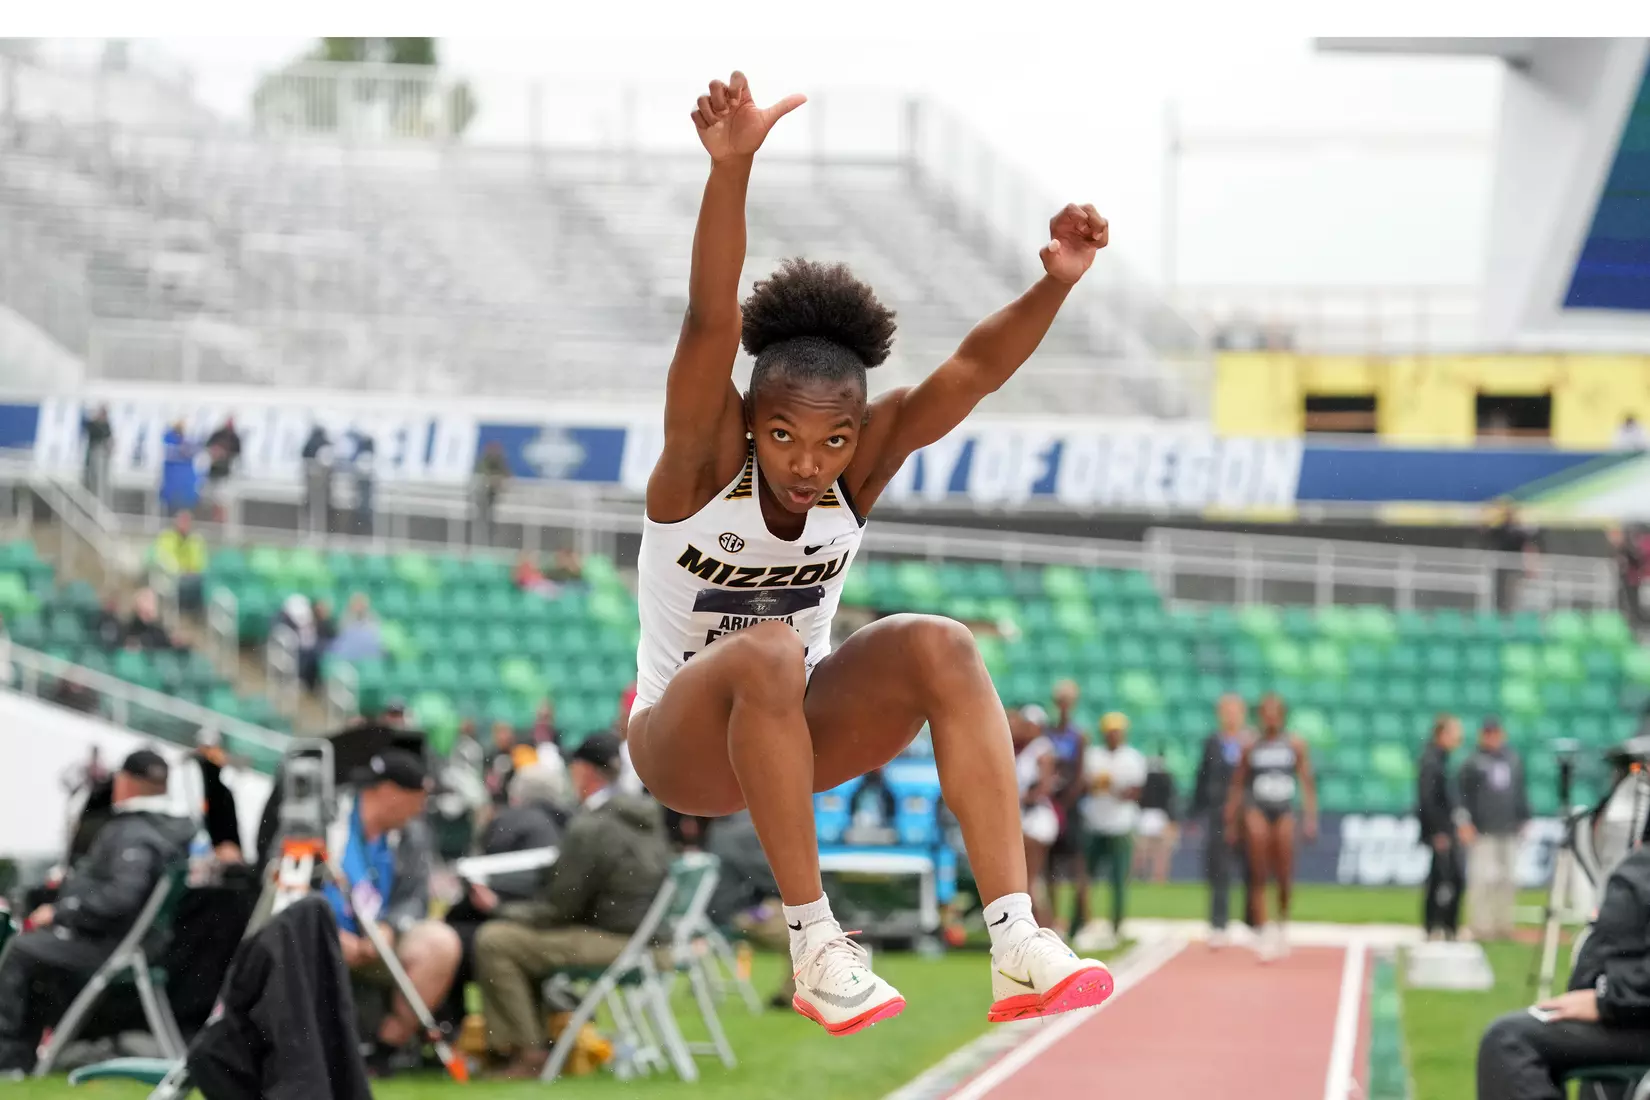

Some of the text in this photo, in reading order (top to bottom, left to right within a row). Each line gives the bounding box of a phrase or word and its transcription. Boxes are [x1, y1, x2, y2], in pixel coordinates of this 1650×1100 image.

[1056, 433, 1302, 507] OREGON
[676, 543, 849, 588] MIZZOU
[720, 534, 744, 552] SEC
